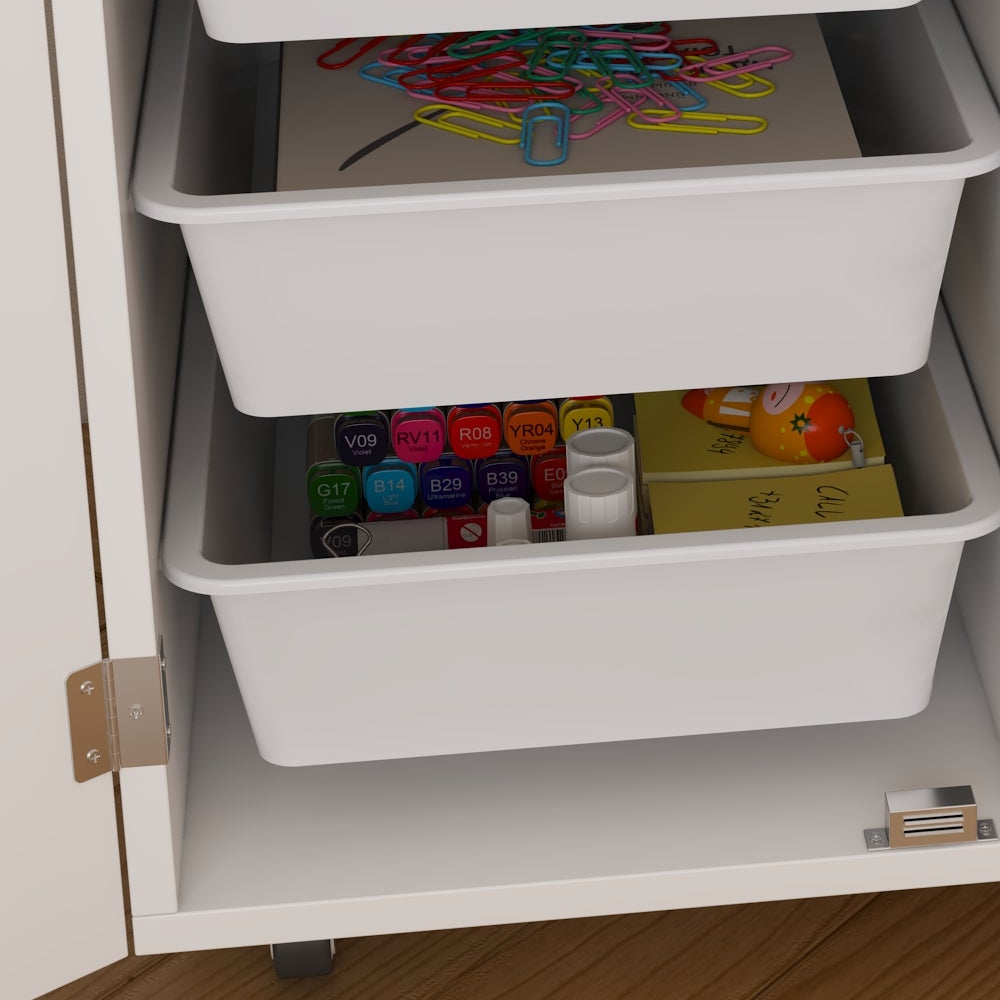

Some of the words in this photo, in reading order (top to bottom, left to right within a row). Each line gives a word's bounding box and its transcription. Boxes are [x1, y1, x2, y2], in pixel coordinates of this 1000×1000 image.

[397, 429, 440, 446] RV11
[459, 426, 492, 441] R08
[510, 423, 554, 438] YR04
[344, 433, 378, 449] V09
[520, 444, 546, 452] Orange
[486, 471, 519, 486] B39
[544, 467, 566, 482] E0
[317, 482, 351, 497] G17
[373, 478, 406, 493] B14
[430, 477, 462, 493] B29
[814, 484, 850, 519] CALL
